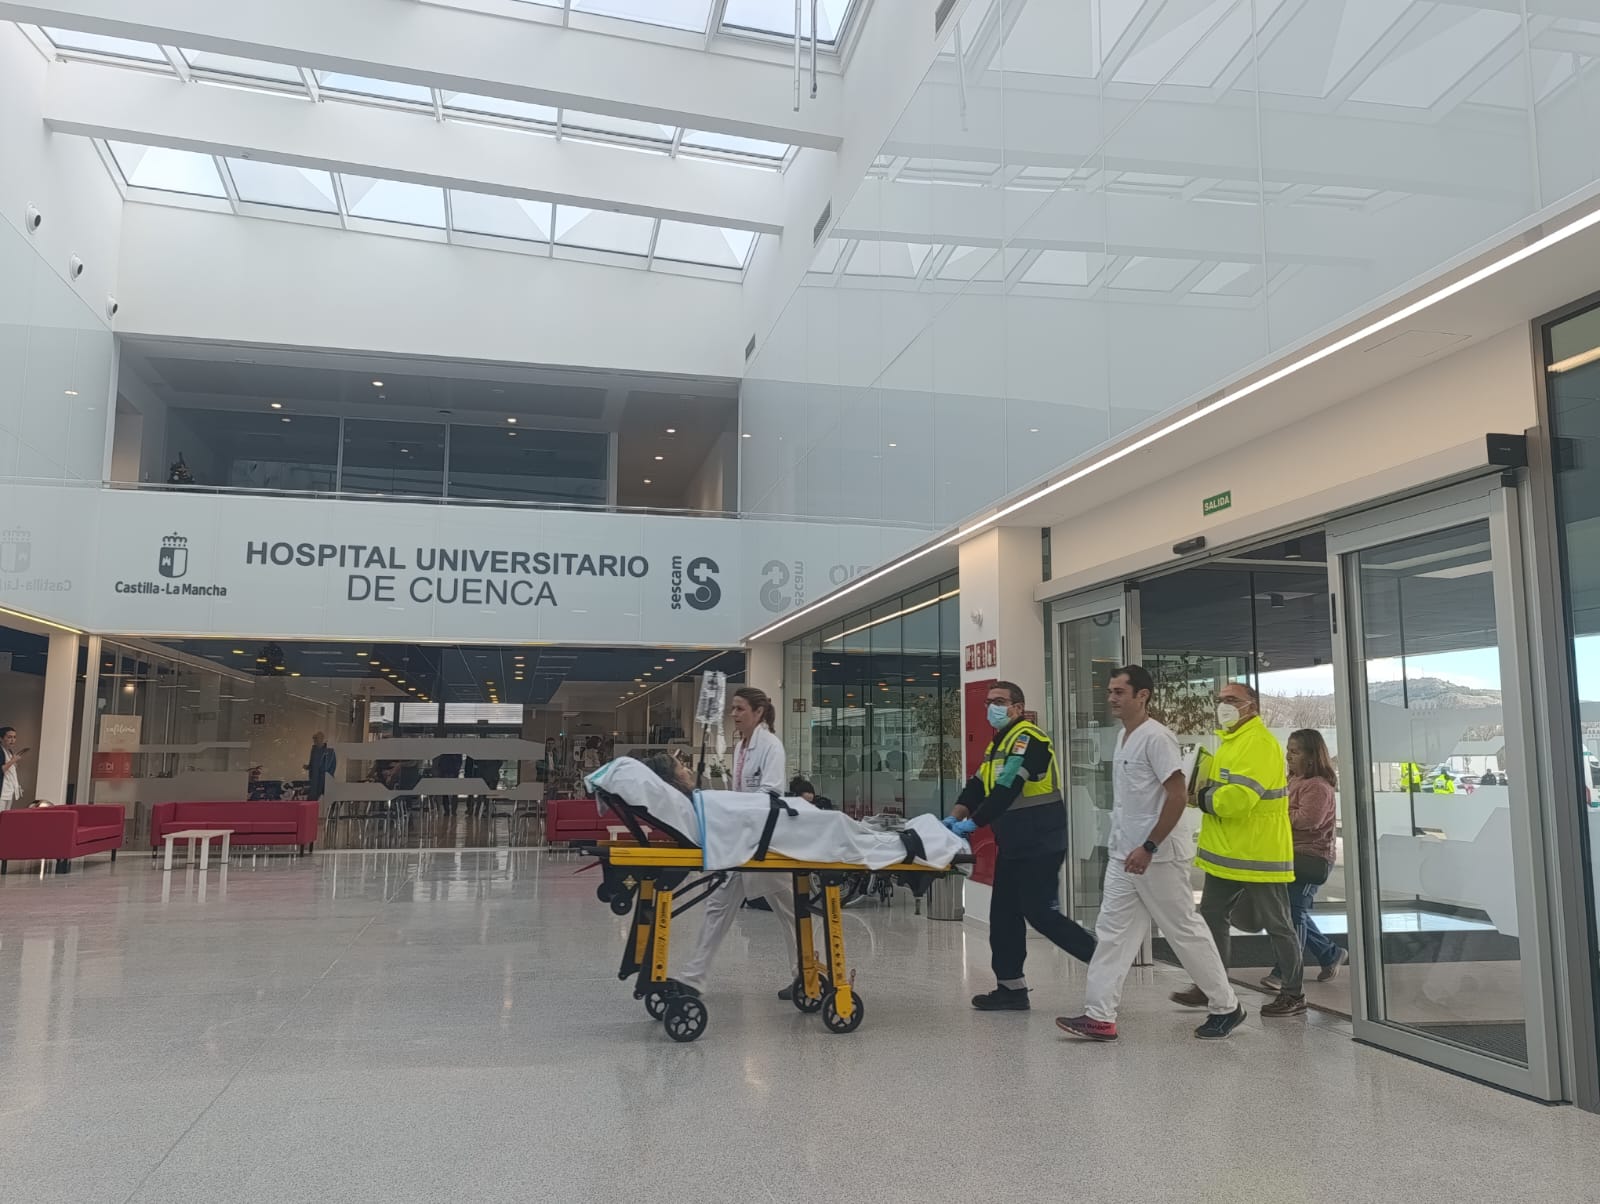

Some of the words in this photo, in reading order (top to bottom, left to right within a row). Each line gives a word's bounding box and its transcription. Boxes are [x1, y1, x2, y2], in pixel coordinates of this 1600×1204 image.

[1204, 496, 1230, 511] SALIDA
[246, 541, 406, 570] HOSPITAL
[416, 548, 649, 578] UNIVERSITARIO
[181, 583, 228, 597] Mancha
[347, 574, 396, 602] DE
[409, 576, 558, 607] CUENCA
[671, 555, 682, 610] sescam
